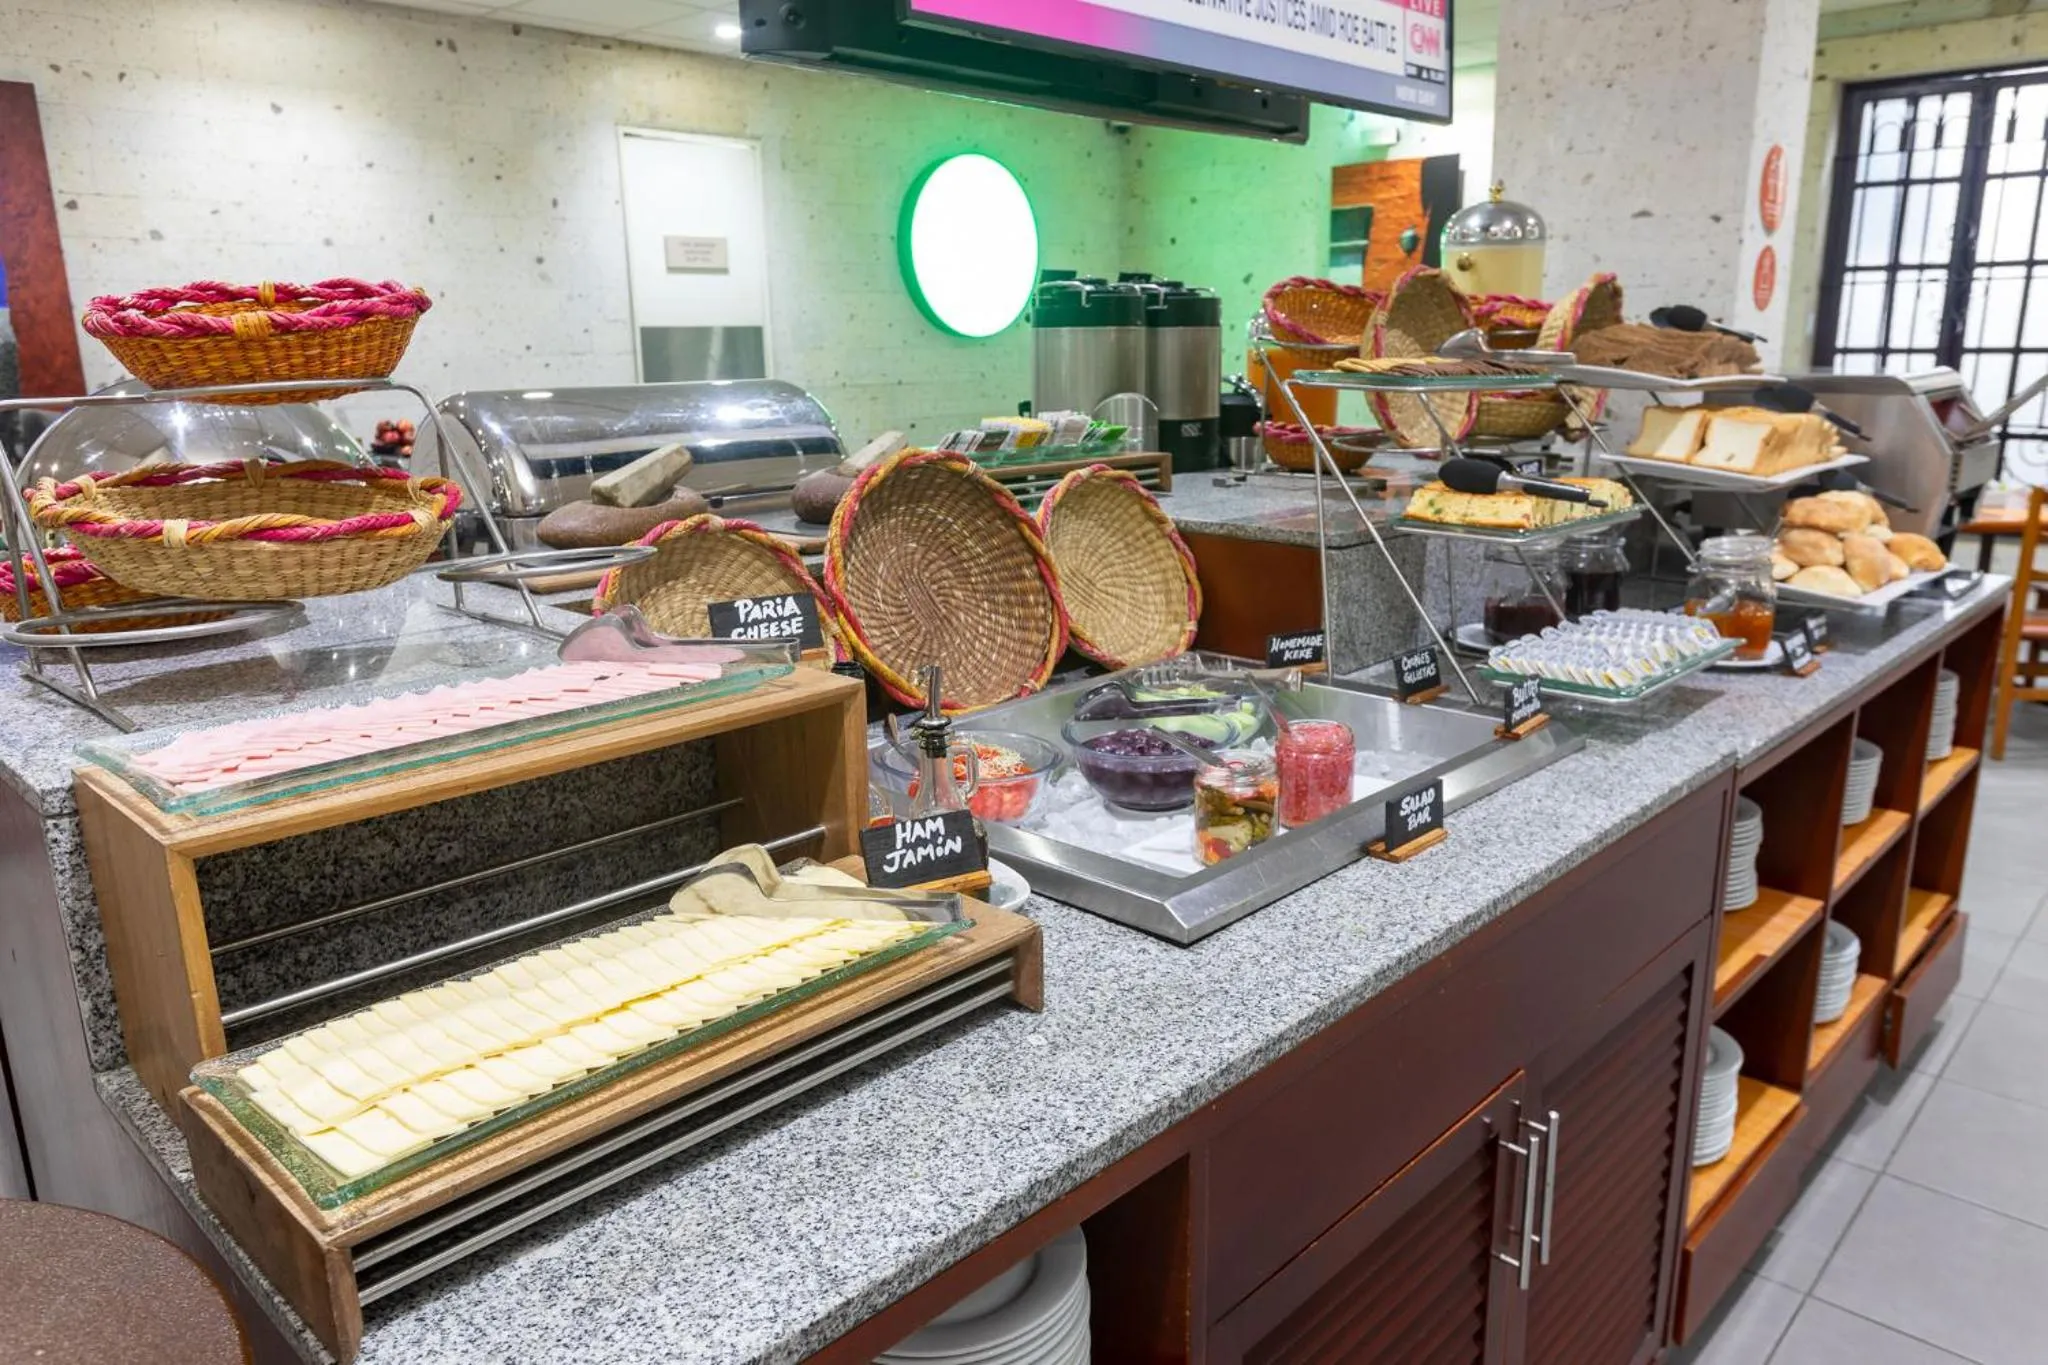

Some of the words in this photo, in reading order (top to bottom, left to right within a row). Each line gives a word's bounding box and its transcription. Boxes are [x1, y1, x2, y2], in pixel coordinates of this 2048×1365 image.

[1361, 17, 1397, 53] BATTLE
[1410, 23, 1440, 57] CNN
[731, 616, 804, 639] CHEESE
[1399, 787, 1436, 816] SALAD
[895, 816, 945, 849] HAM
[1407, 806, 1432, 831] BAR
